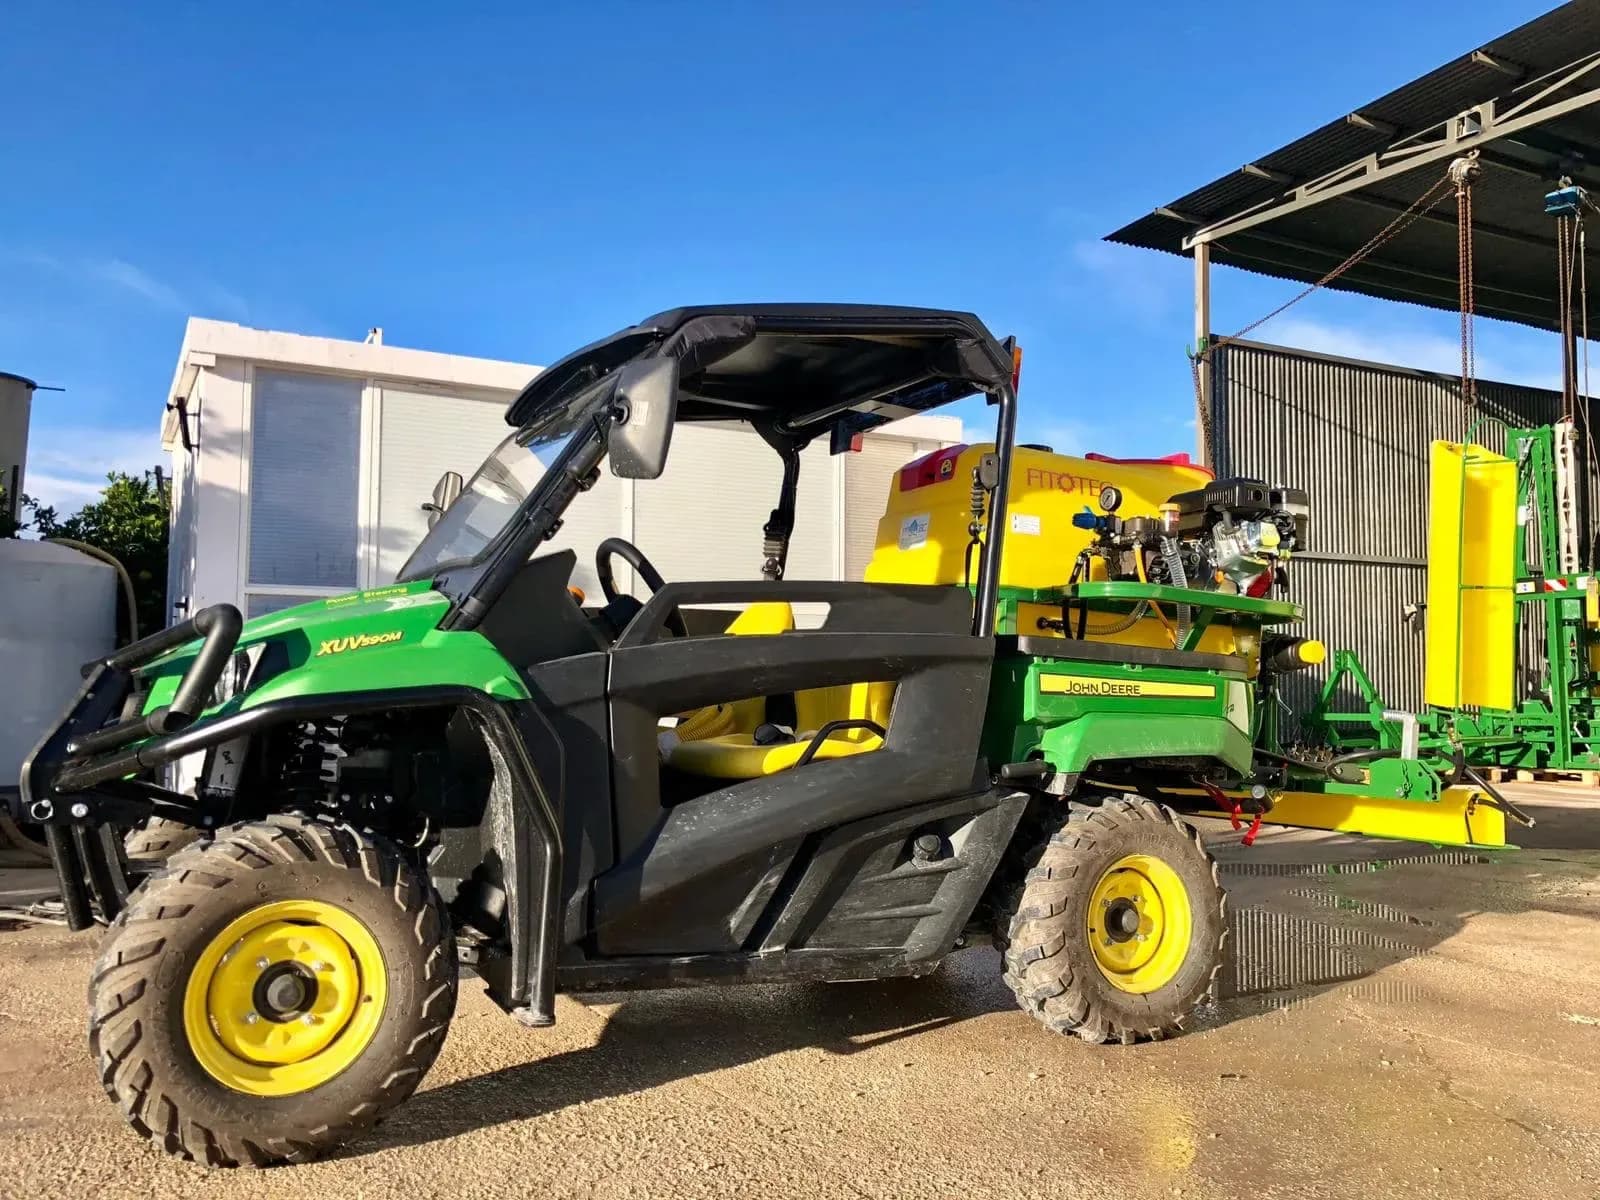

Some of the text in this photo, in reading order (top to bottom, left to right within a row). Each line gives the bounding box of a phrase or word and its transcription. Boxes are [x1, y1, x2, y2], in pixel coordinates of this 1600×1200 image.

[363, 587, 408, 598] Steering
[316, 631, 404, 656] XUV590M
[1065, 680, 1141, 695] JOHN DEERE
